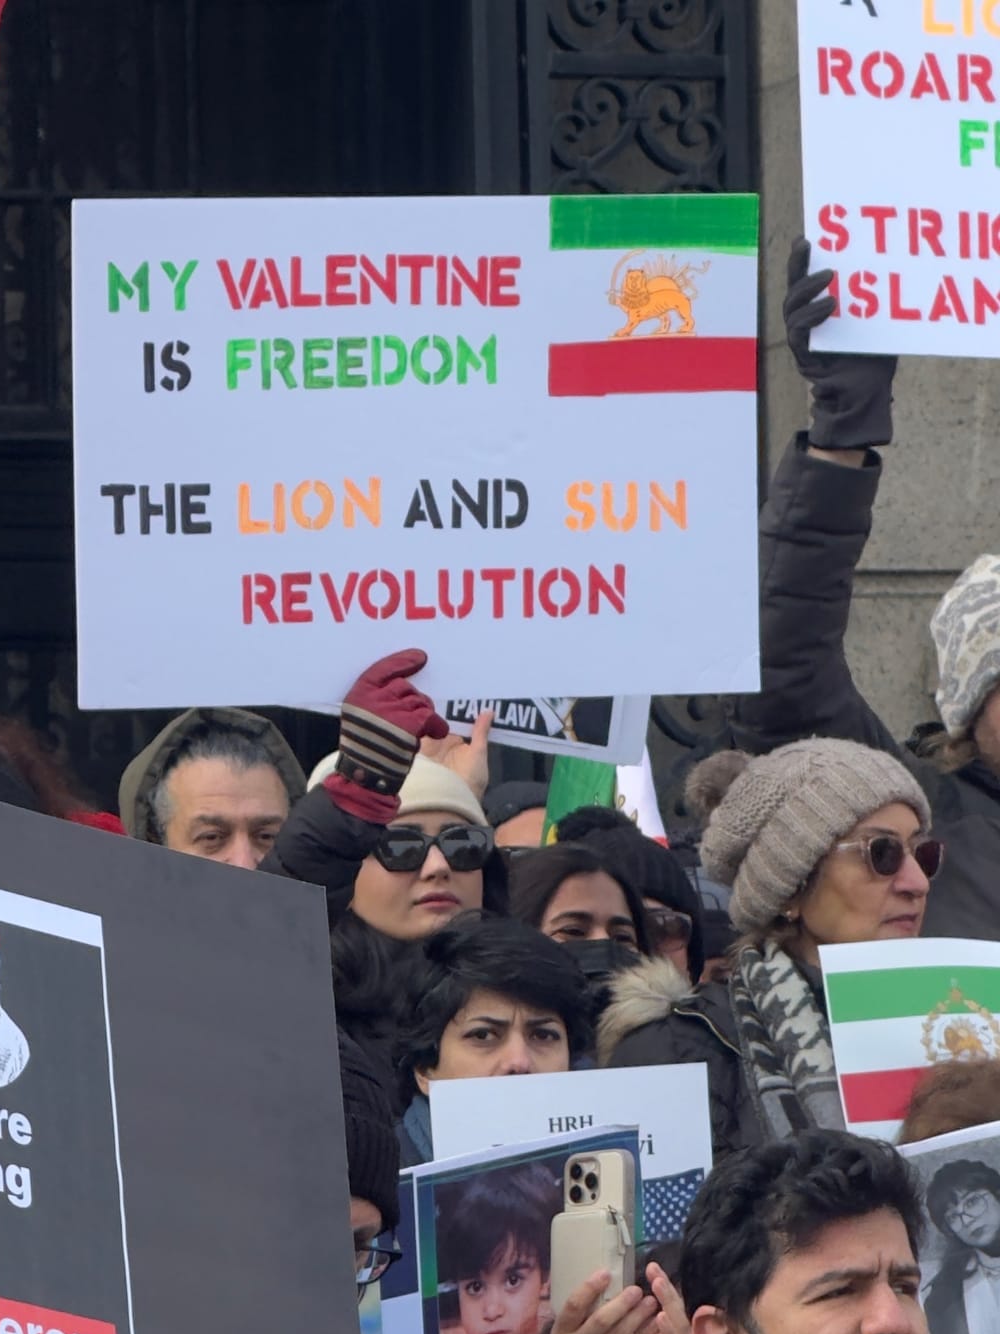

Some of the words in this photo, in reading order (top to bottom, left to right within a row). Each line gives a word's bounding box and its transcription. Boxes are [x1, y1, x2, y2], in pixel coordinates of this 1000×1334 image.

[817, 47, 996, 103] ROAR
[107, 260, 199, 313] MY
[216, 254, 521, 310] VALENTINE
[143, 340, 191, 393] IS
[226, 334, 498, 390] FREEDOM
[100, 482, 212, 536] THE
[238, 477, 381, 535] LION
[403, 478, 529, 530] AND
[565, 480, 687, 532] SUN
[241, 563, 626, 625] REVOLUTION
[548, 1114, 593, 1133] HRH
